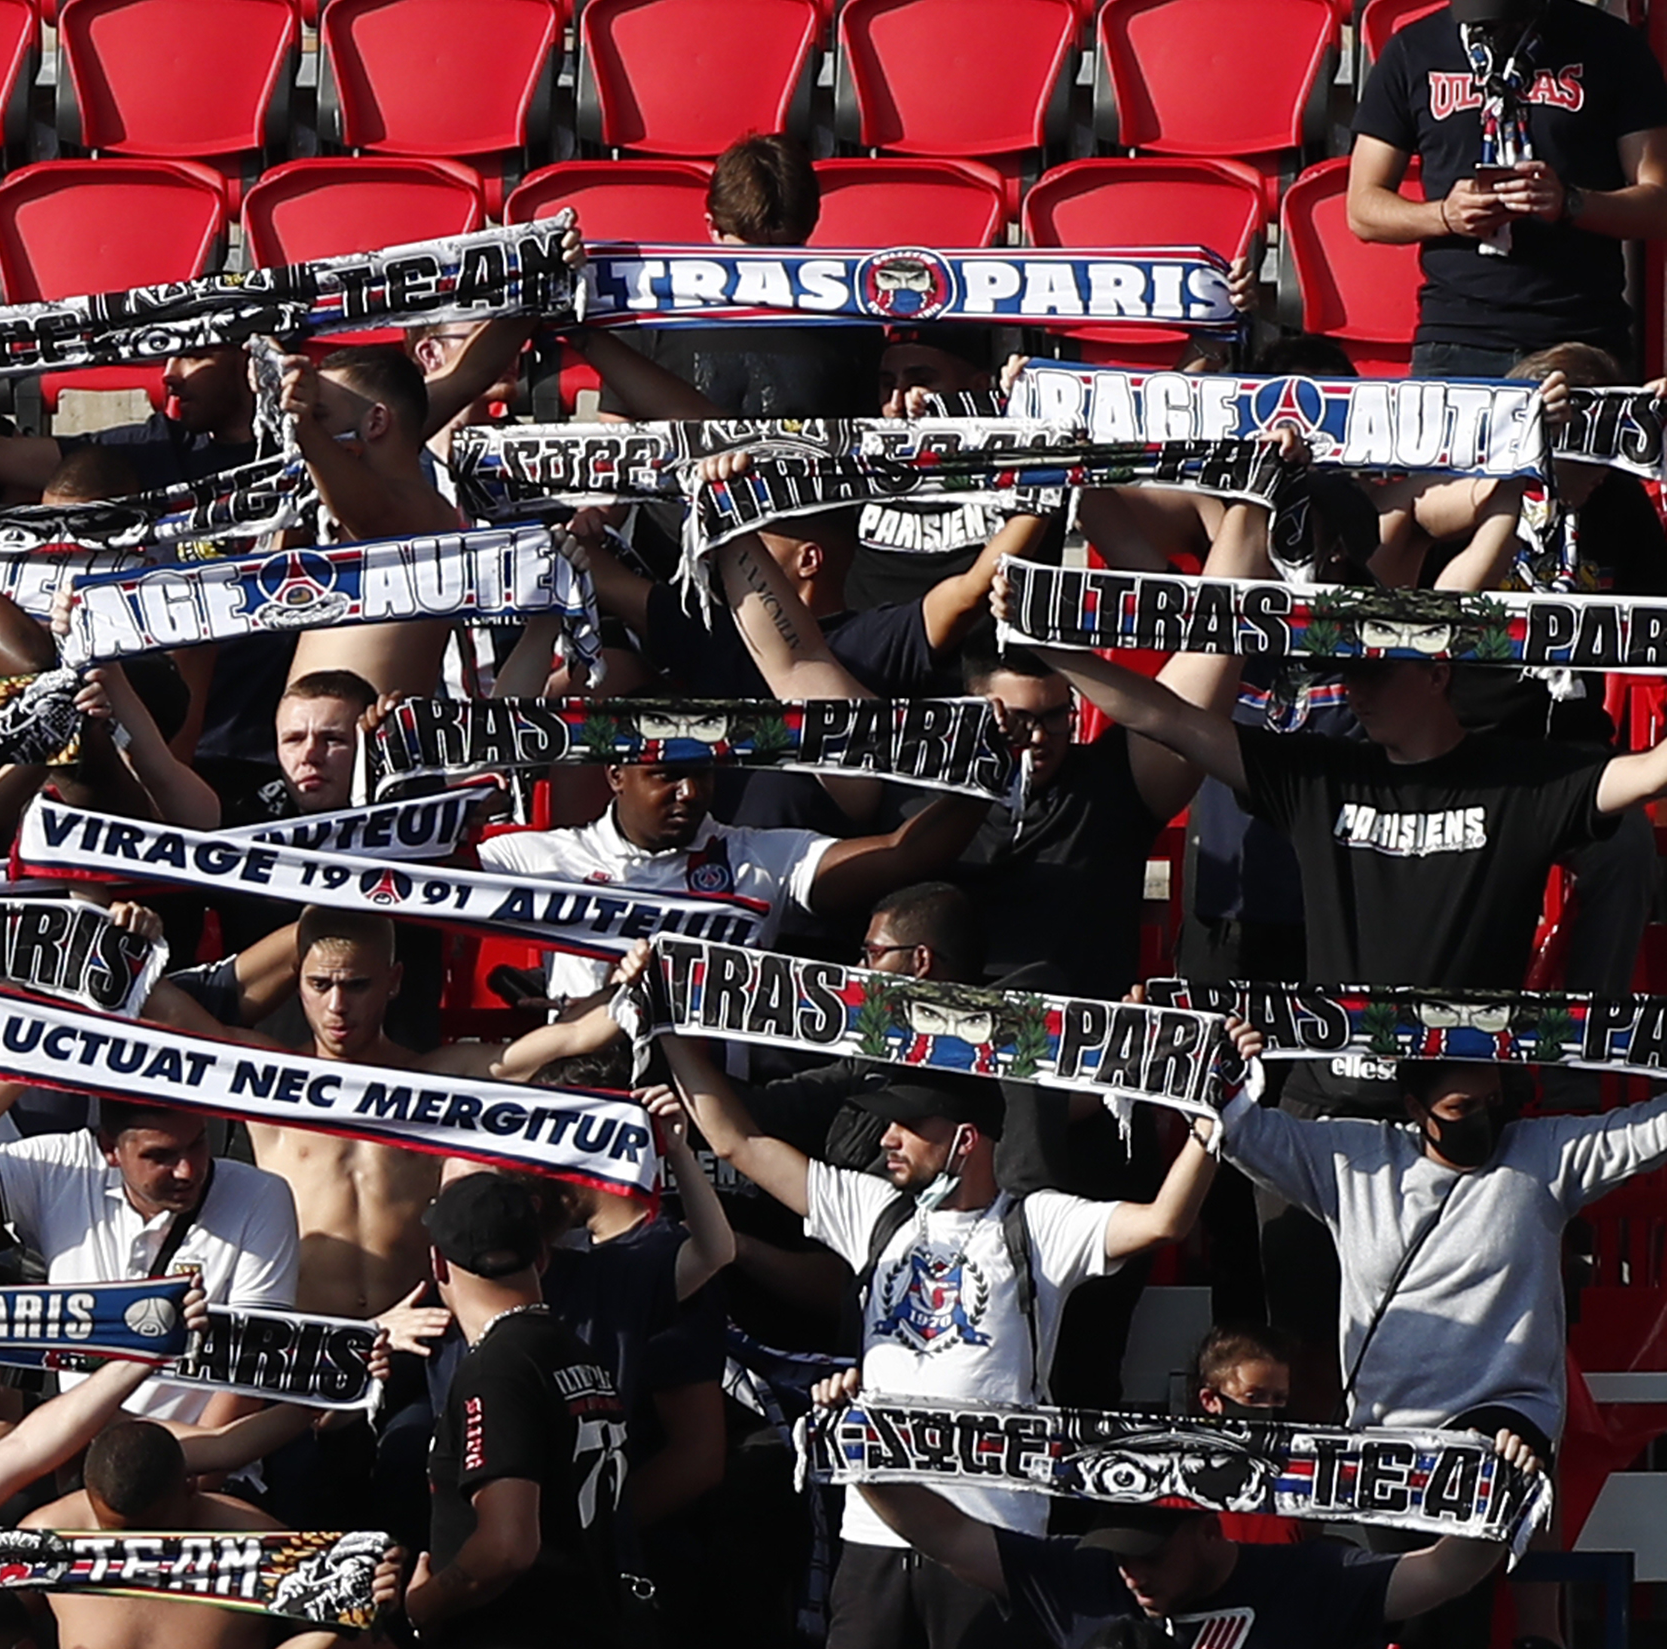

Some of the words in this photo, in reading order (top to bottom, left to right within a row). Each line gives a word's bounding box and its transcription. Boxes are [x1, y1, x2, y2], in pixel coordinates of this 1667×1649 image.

[1428, 64, 1584, 121] ULAS
[341, 229, 567, 315] TEAM
[961, 261, 1237, 320] PARIS
[1033, 368, 1243, 443] RAGE
[1342, 381, 1540, 473] AUTE
[1008, 563, 1294, 656] ULTRAS
[263, 799, 467, 853] AUTEUI
[1334, 803, 1486, 851] PARISIENS
[39, 807, 280, 885] VIRAGE
[300, 860, 351, 895] 19
[420, 879, 470, 911] 91
[1331, 1056, 1397, 1081] elles
[228, 1061, 343, 1109] NEC
[355, 1081, 650, 1165] MERGITUR
[906, 1309, 953, 1328] 1970
[73, 1536, 262, 1598] TEAM
